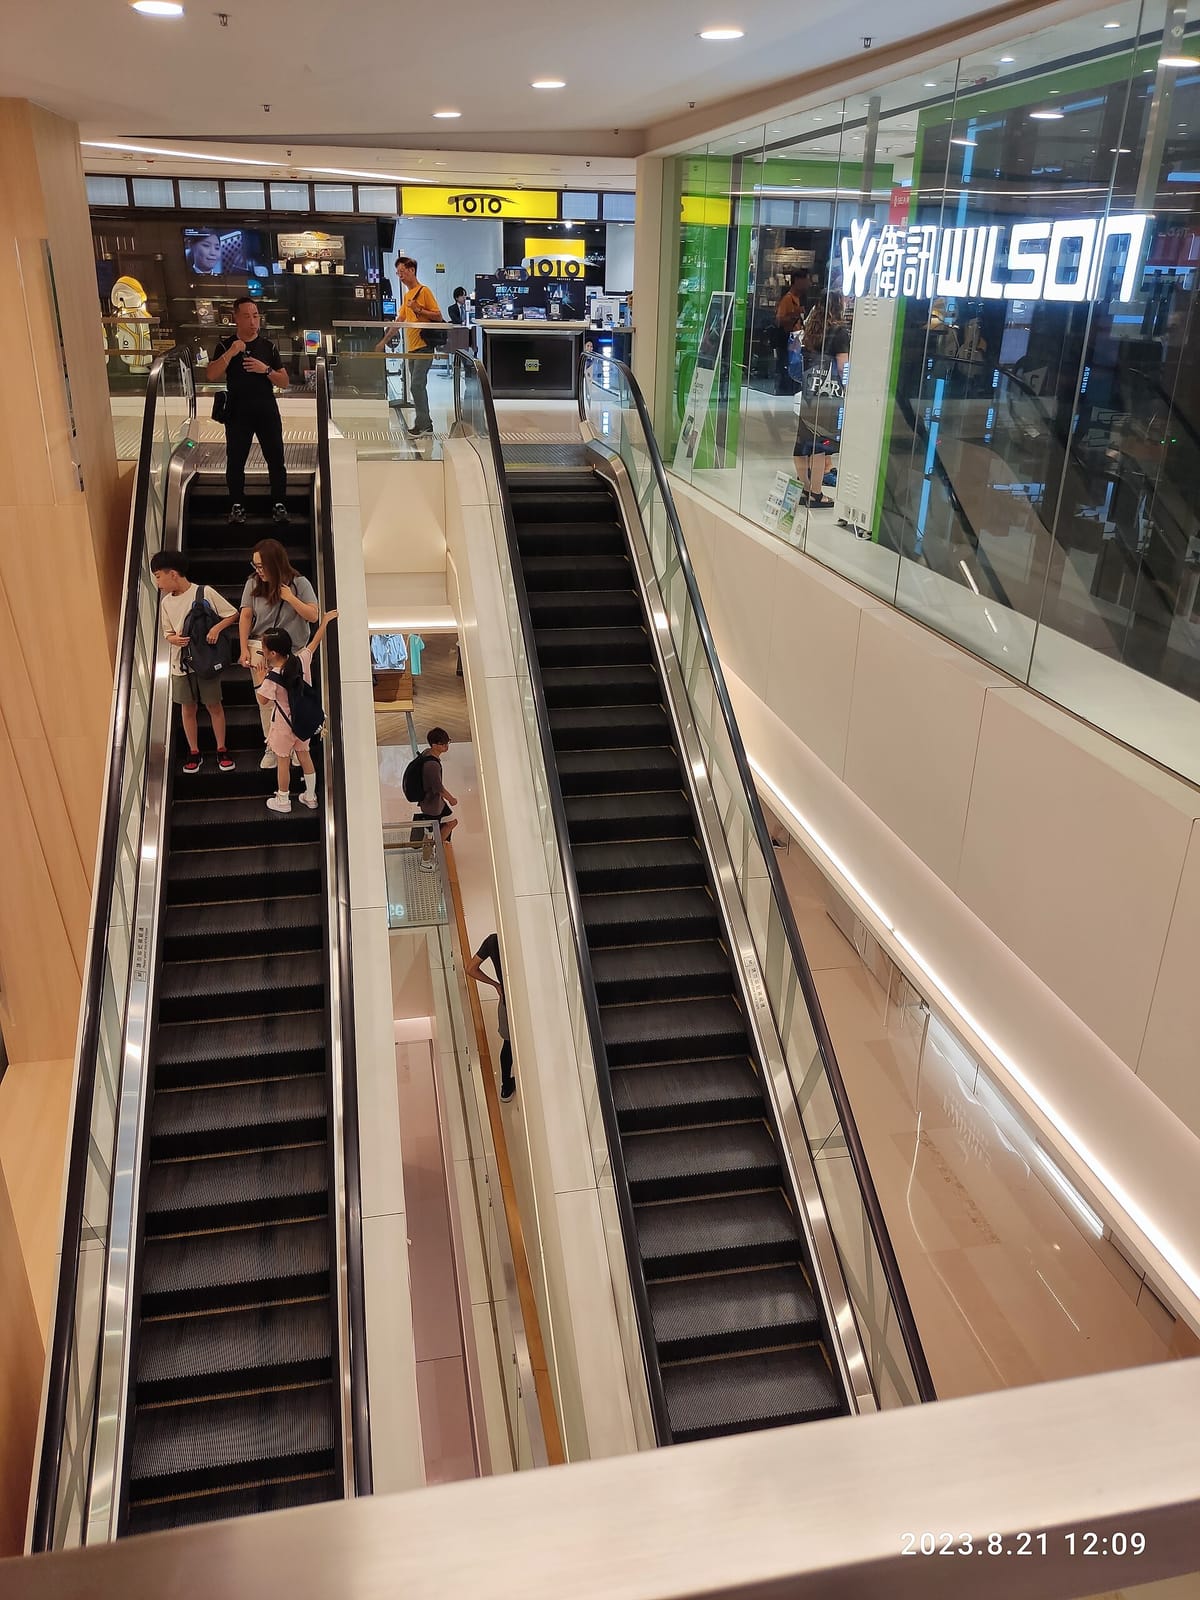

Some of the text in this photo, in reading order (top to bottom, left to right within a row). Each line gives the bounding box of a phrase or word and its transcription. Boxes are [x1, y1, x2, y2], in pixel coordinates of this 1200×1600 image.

[453, 195, 503, 214] 1010
[529, 258, 582, 278] 1010
[876, 224, 936, 300] 衛訊
[937, 214, 1149, 303] WILSON
